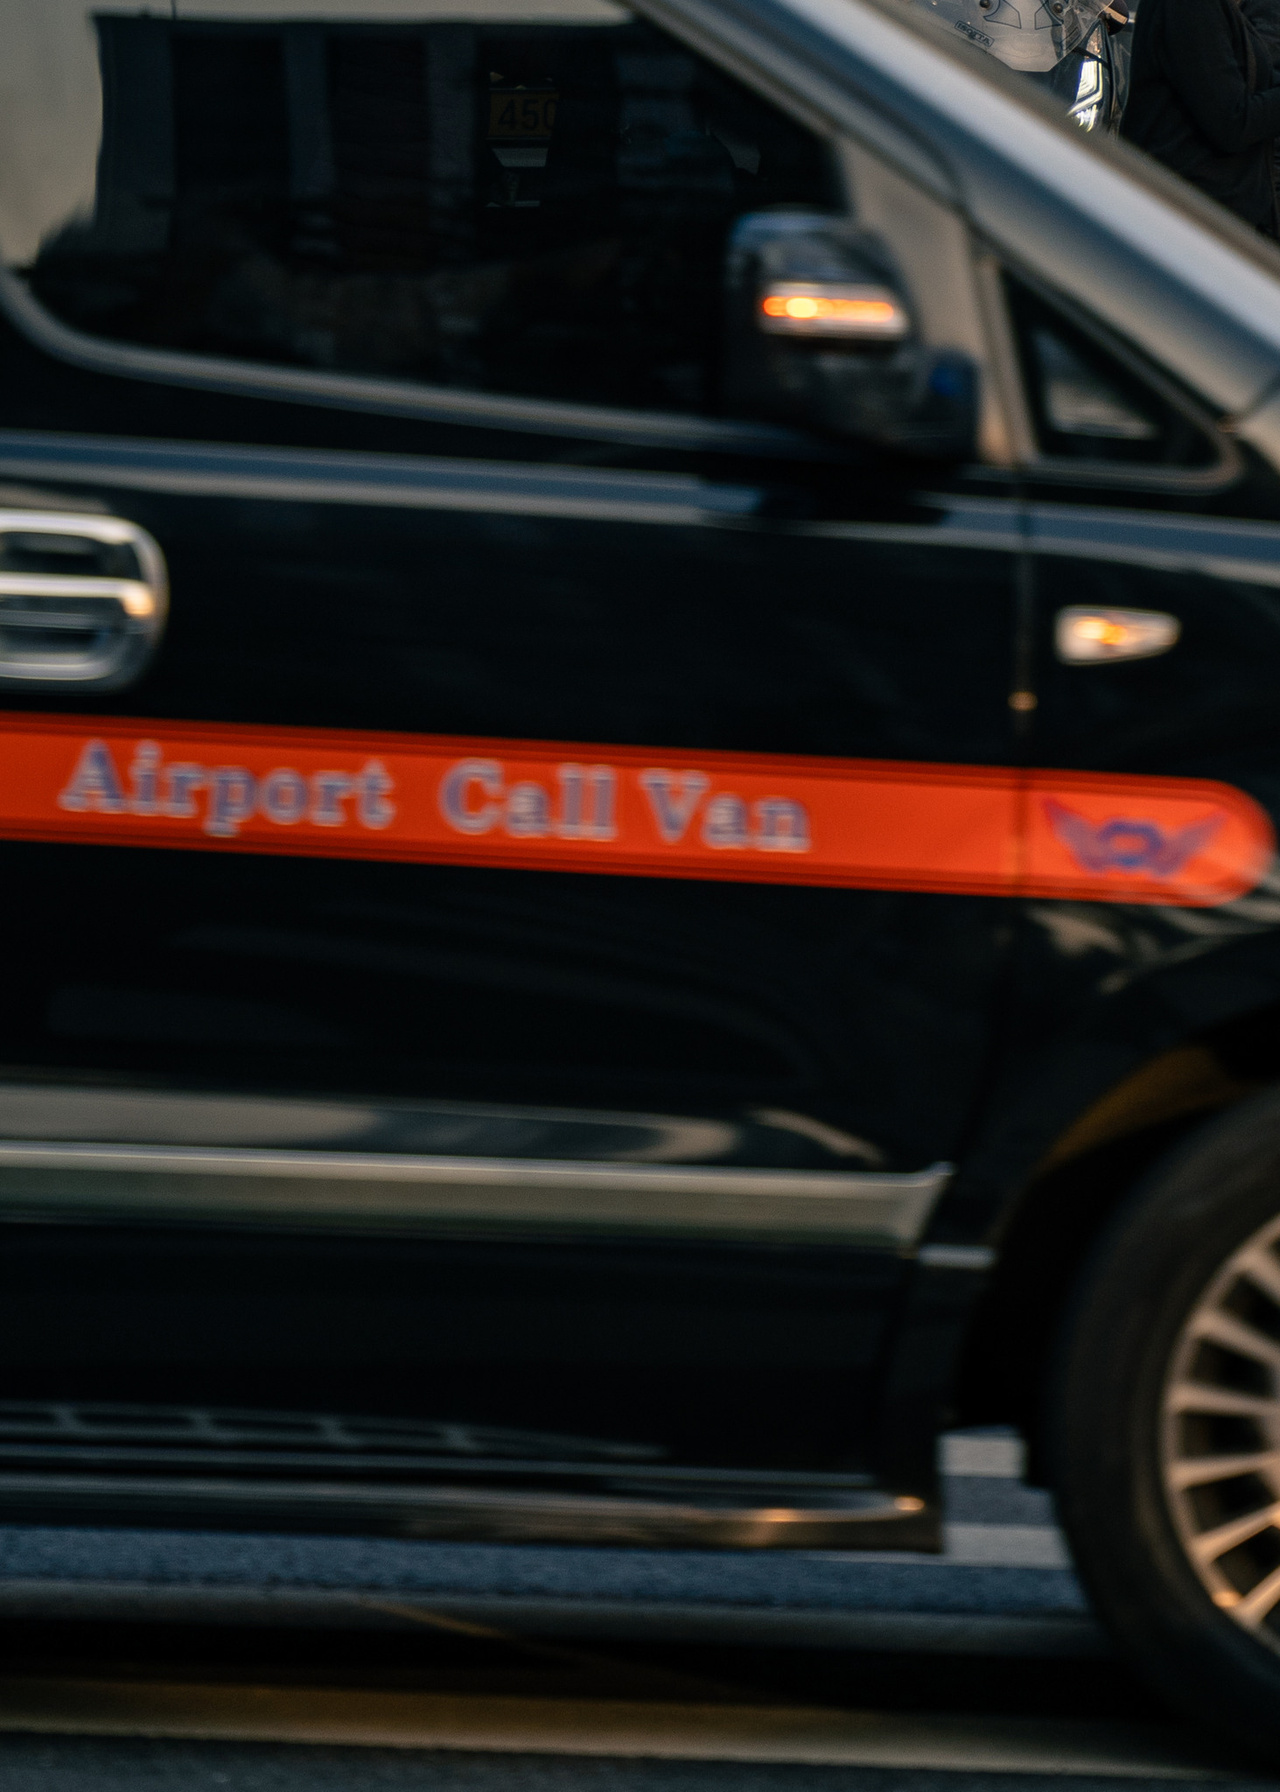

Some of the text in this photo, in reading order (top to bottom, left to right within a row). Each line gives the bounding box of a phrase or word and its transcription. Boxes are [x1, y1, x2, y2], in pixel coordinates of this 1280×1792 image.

[59, 738, 812, 854] Airport Call Van
